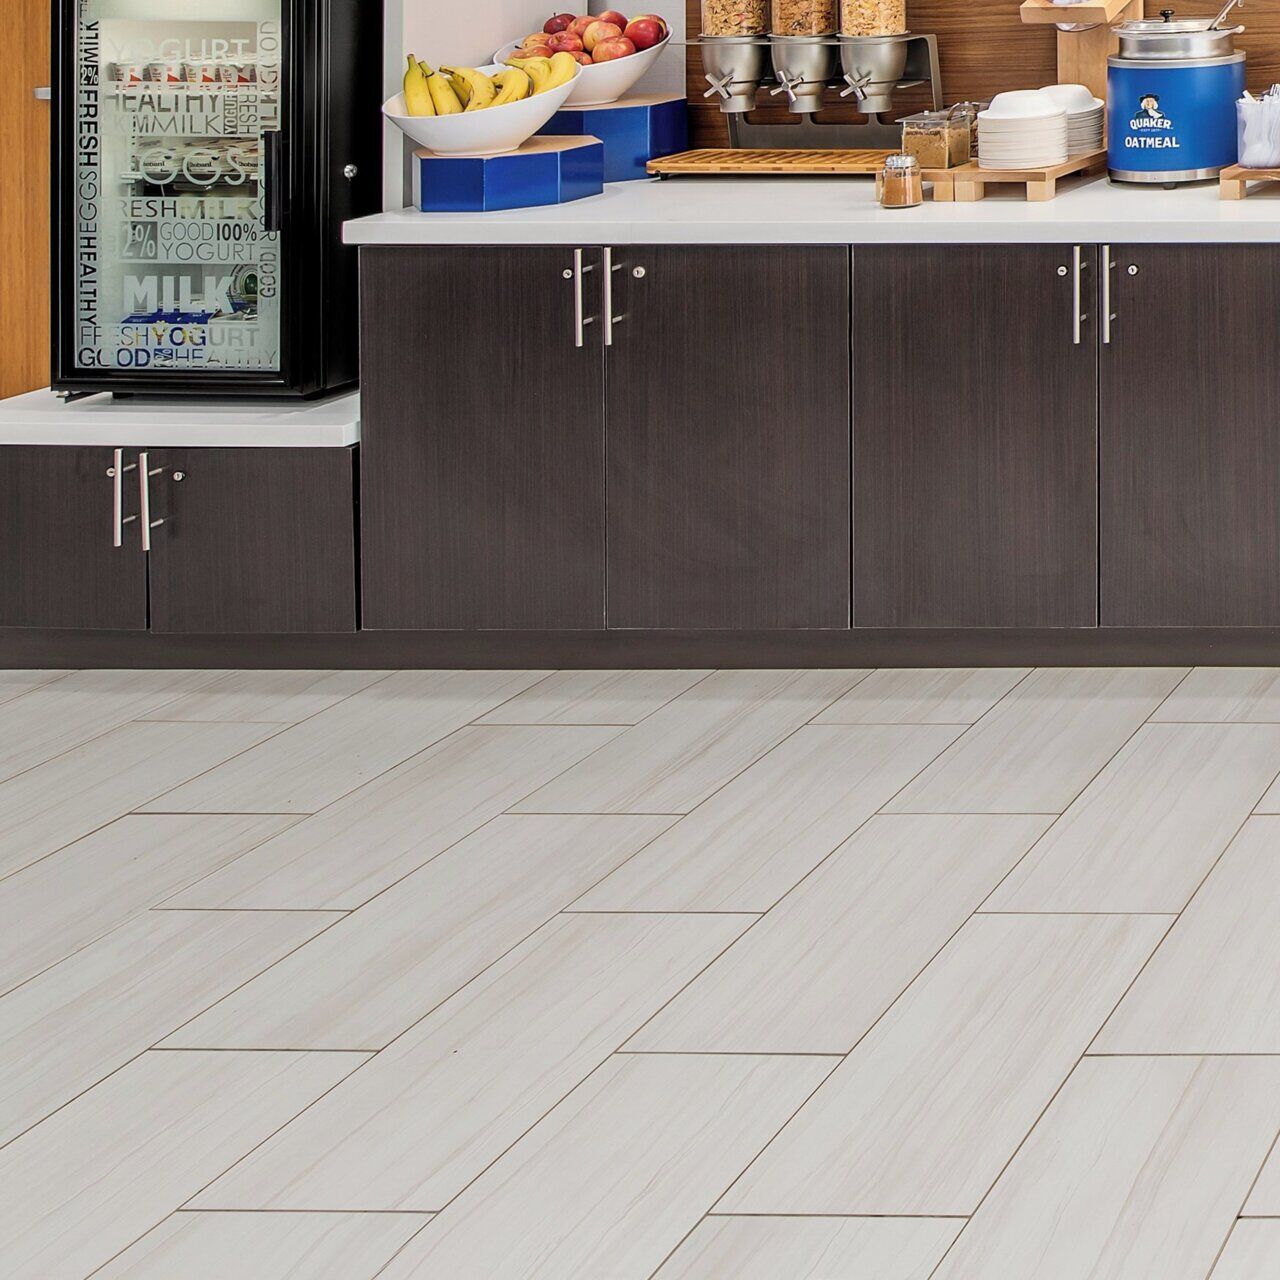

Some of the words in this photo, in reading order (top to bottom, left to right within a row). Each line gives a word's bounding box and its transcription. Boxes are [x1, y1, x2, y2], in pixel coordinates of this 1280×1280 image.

[79, 89, 98, 167] FRESH
[1125, 136, 1180, 149] OATMEAL
[1129, 118, 1172, 130] QUAKER
[138, 147, 247, 185] GGS
[79, 170, 97, 234] EGGS
[118, 200, 177, 218] RESH
[160, 221, 214, 241] GOOD
[216, 222, 258, 242] 100%
[161, 242, 256, 262] YOGURT
[79, 236, 97, 326] HEALTHY
[259, 252, 277, 298] GOOD
[123, 275, 235, 314] MILK
